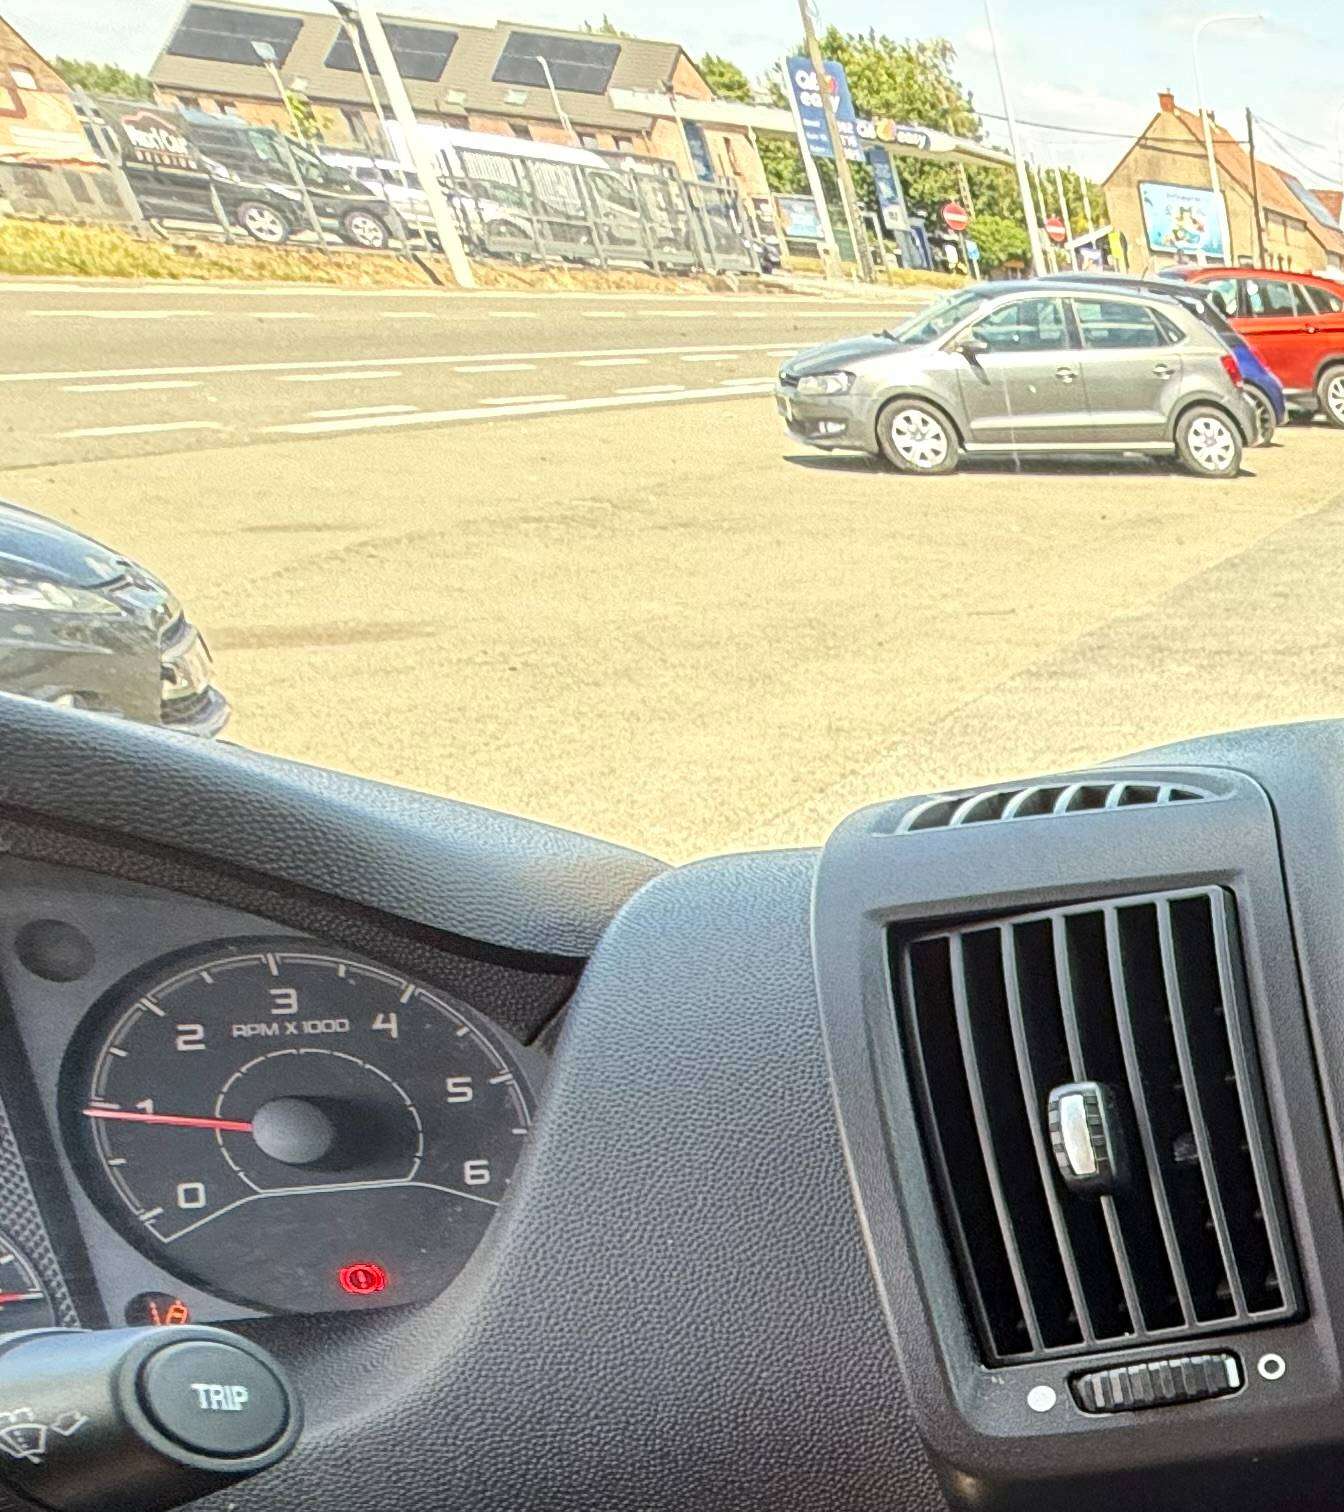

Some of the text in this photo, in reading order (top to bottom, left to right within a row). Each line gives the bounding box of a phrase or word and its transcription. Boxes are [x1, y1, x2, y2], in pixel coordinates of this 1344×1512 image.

[800, 91, 841, 113] eay
[269, 988, 299, 1015] 3
[176, 1023, 207, 1052] 2
[232, 1022, 280, 1039] RPM
[302, 1018, 351, 1034] 1000
[371, 1012, 399, 1039] 4
[446, 1075, 474, 1103] 5
[463, 1158, 491, 1186] 6
[176, 1181, 206, 1209] 0
[191, 1382, 249, 1411] TRIP
